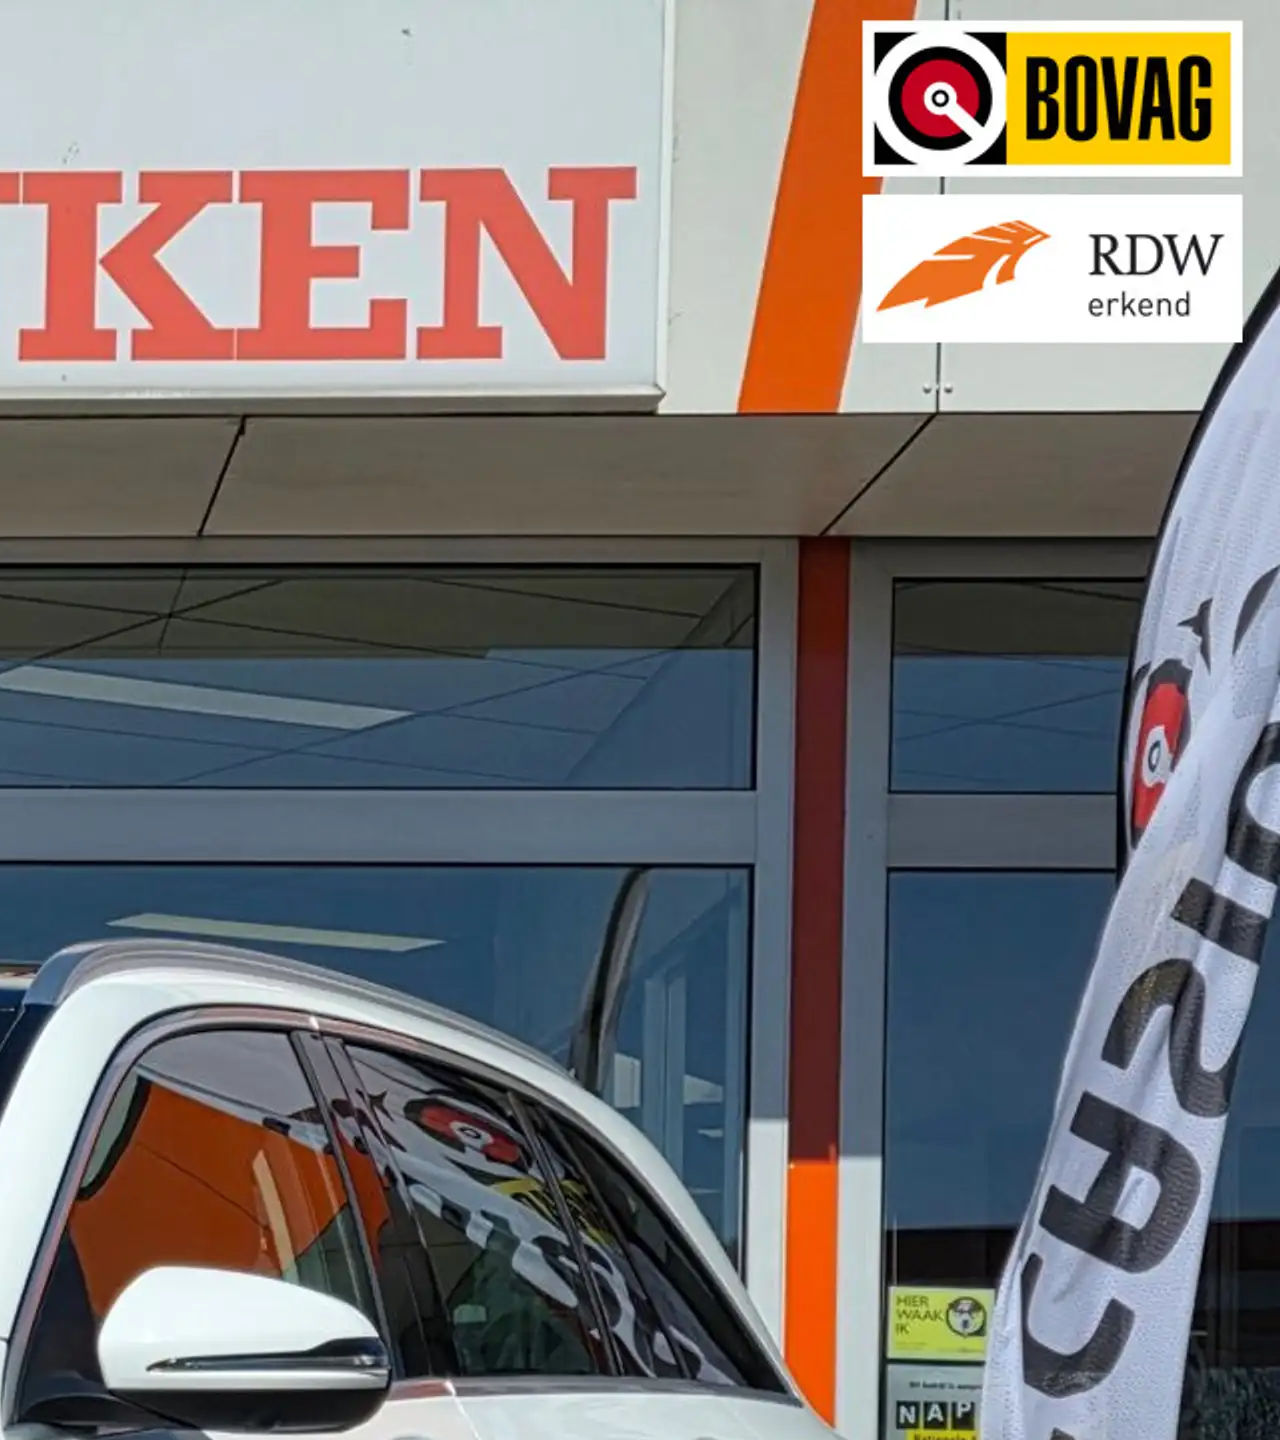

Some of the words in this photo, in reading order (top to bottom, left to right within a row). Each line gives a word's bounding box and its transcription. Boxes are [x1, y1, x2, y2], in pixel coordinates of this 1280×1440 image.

[896, 1295, 929, 1308] HIER
[896, 1309, 945, 1322] WAAK
[895, 1323, 911, 1336] IK
[898, 1403, 972, 1425] NAP
